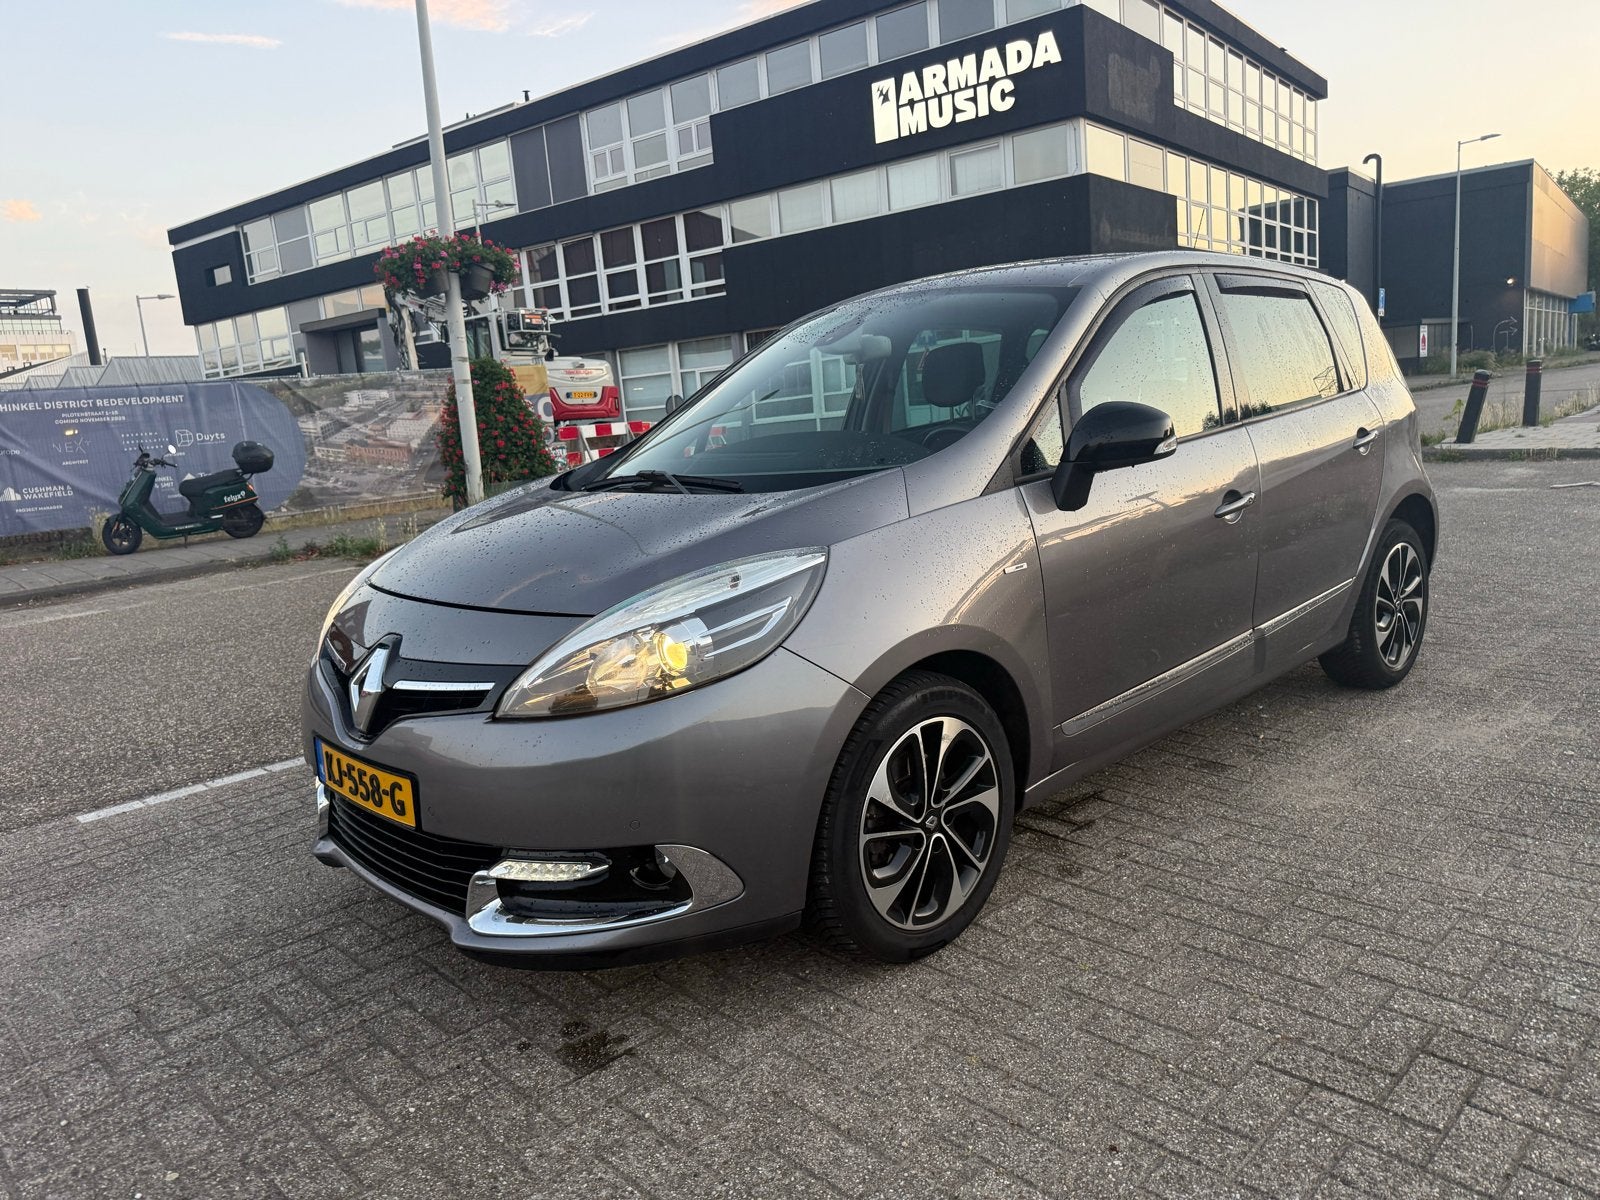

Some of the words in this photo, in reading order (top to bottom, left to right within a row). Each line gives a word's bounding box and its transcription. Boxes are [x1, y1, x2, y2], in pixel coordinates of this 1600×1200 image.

[899, 29, 1062, 105] ARMADA
[899, 78, 1015, 137] MUSIC
[0, 402, 42, 412] HINKEL
[44, 399, 94, 410] DISTRICT
[96, 394, 184, 407] REDEVELOPMENT
[196, 432, 226, 441] Duyts
[22, 485, 64, 494] CUSHMAN
[23, 490, 74, 500] WAKEFIELD
